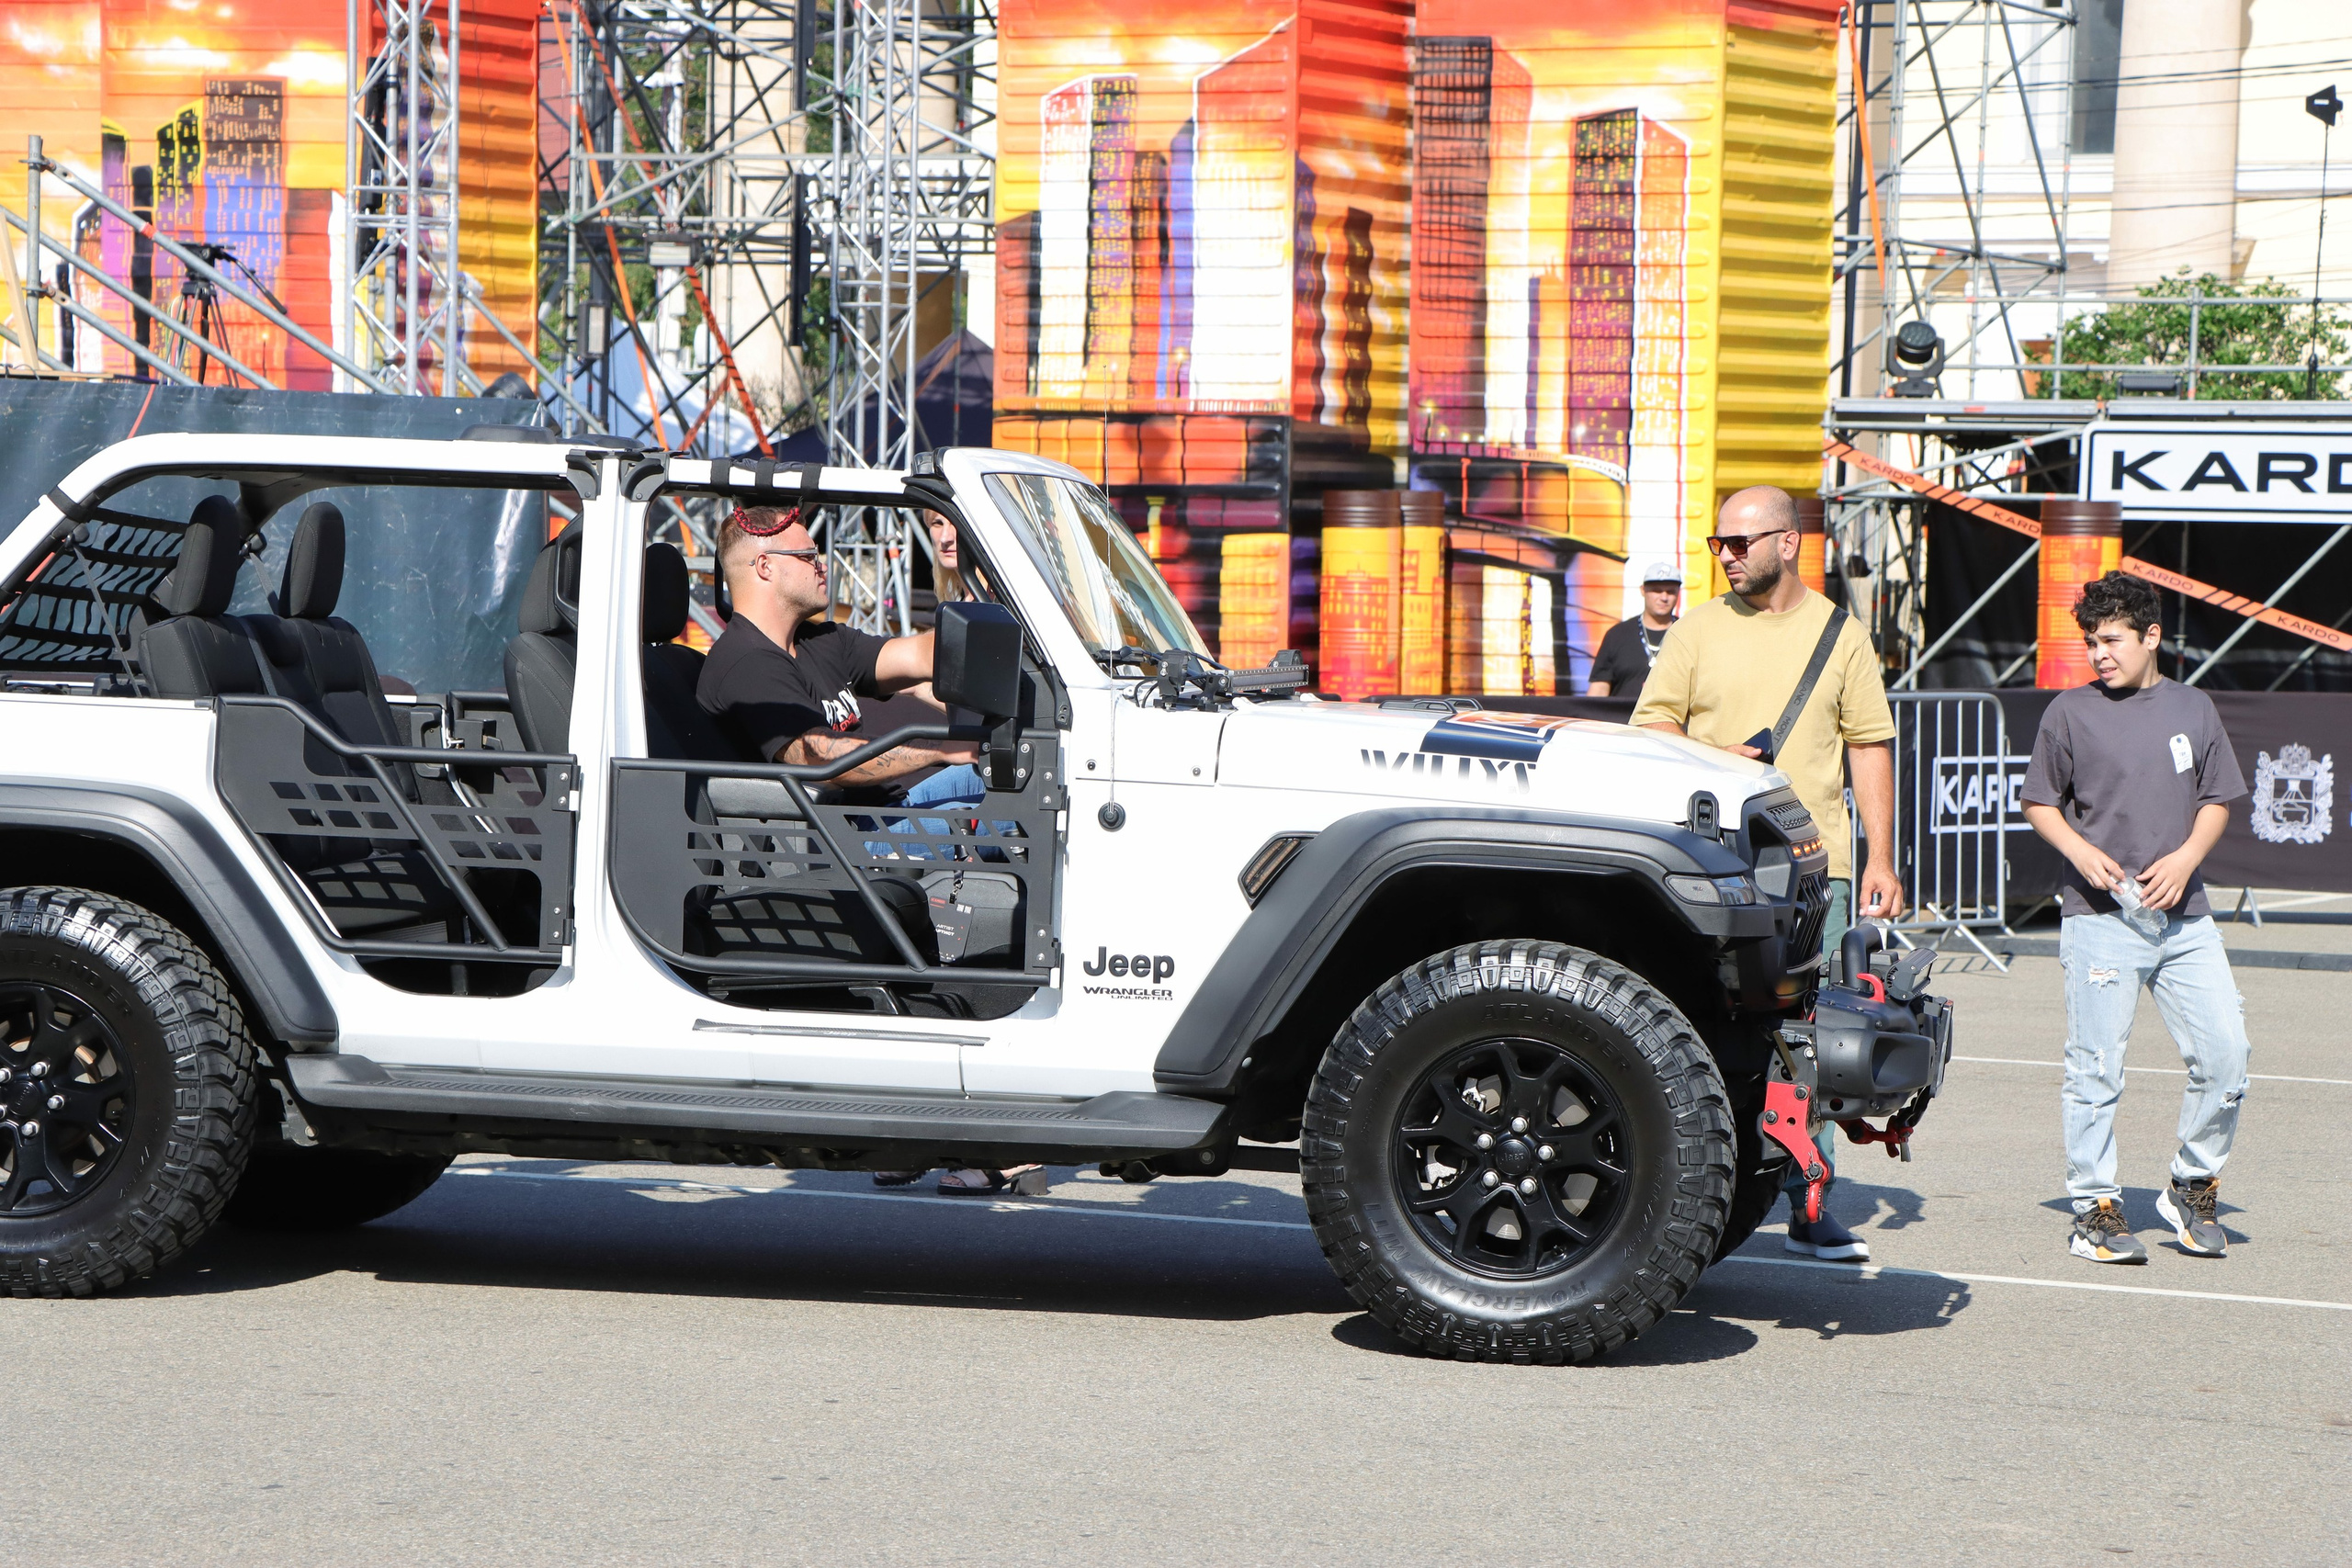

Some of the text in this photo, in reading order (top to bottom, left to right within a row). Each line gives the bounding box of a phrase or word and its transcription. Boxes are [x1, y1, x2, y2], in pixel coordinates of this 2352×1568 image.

[1860, 457, 1916, 485] KARDO
[2132, 563, 2194, 591] KARDO
[2277, 615, 2341, 643] KARDO
[1774, 715, 1792, 745] MONT
[1082, 945, 1175, 984] Jeep
[1082, 986, 1172, 998] WRANGLER
[1480, 1002, 1633, 1074] ATLANDER
[1411, 1269, 1589, 1313] ROVERCLAW
